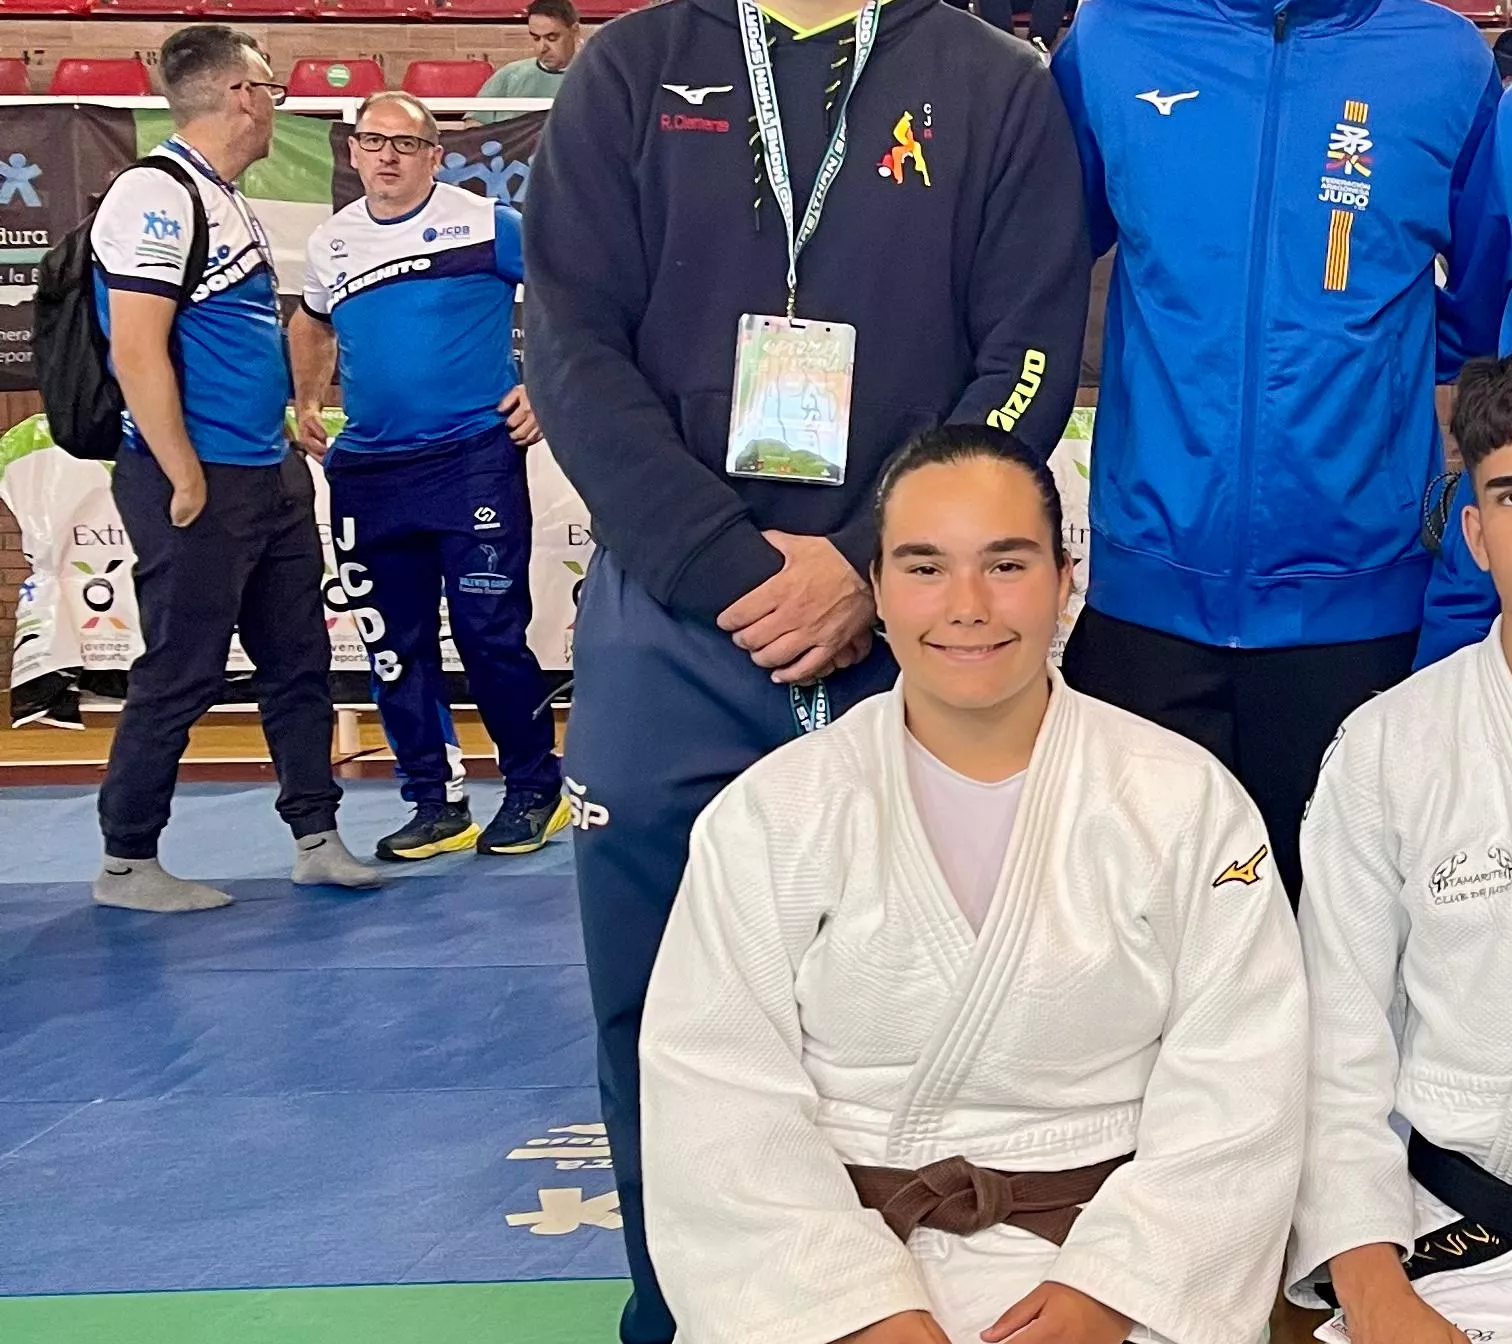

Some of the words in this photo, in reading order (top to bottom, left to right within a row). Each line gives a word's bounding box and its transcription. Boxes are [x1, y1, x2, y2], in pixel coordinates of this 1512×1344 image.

[742, 2, 768, 66] SPORT
[753, 67, 777, 125] THAN
[765, 124, 786, 185] MORE
[811, 155, 839, 212] THAN
[1318, 189, 1369, 207] JUDO
[439, 225, 470, 236] JCDB
[347, 257, 432, 294] BENITO
[335, 517, 403, 682] JCDB
